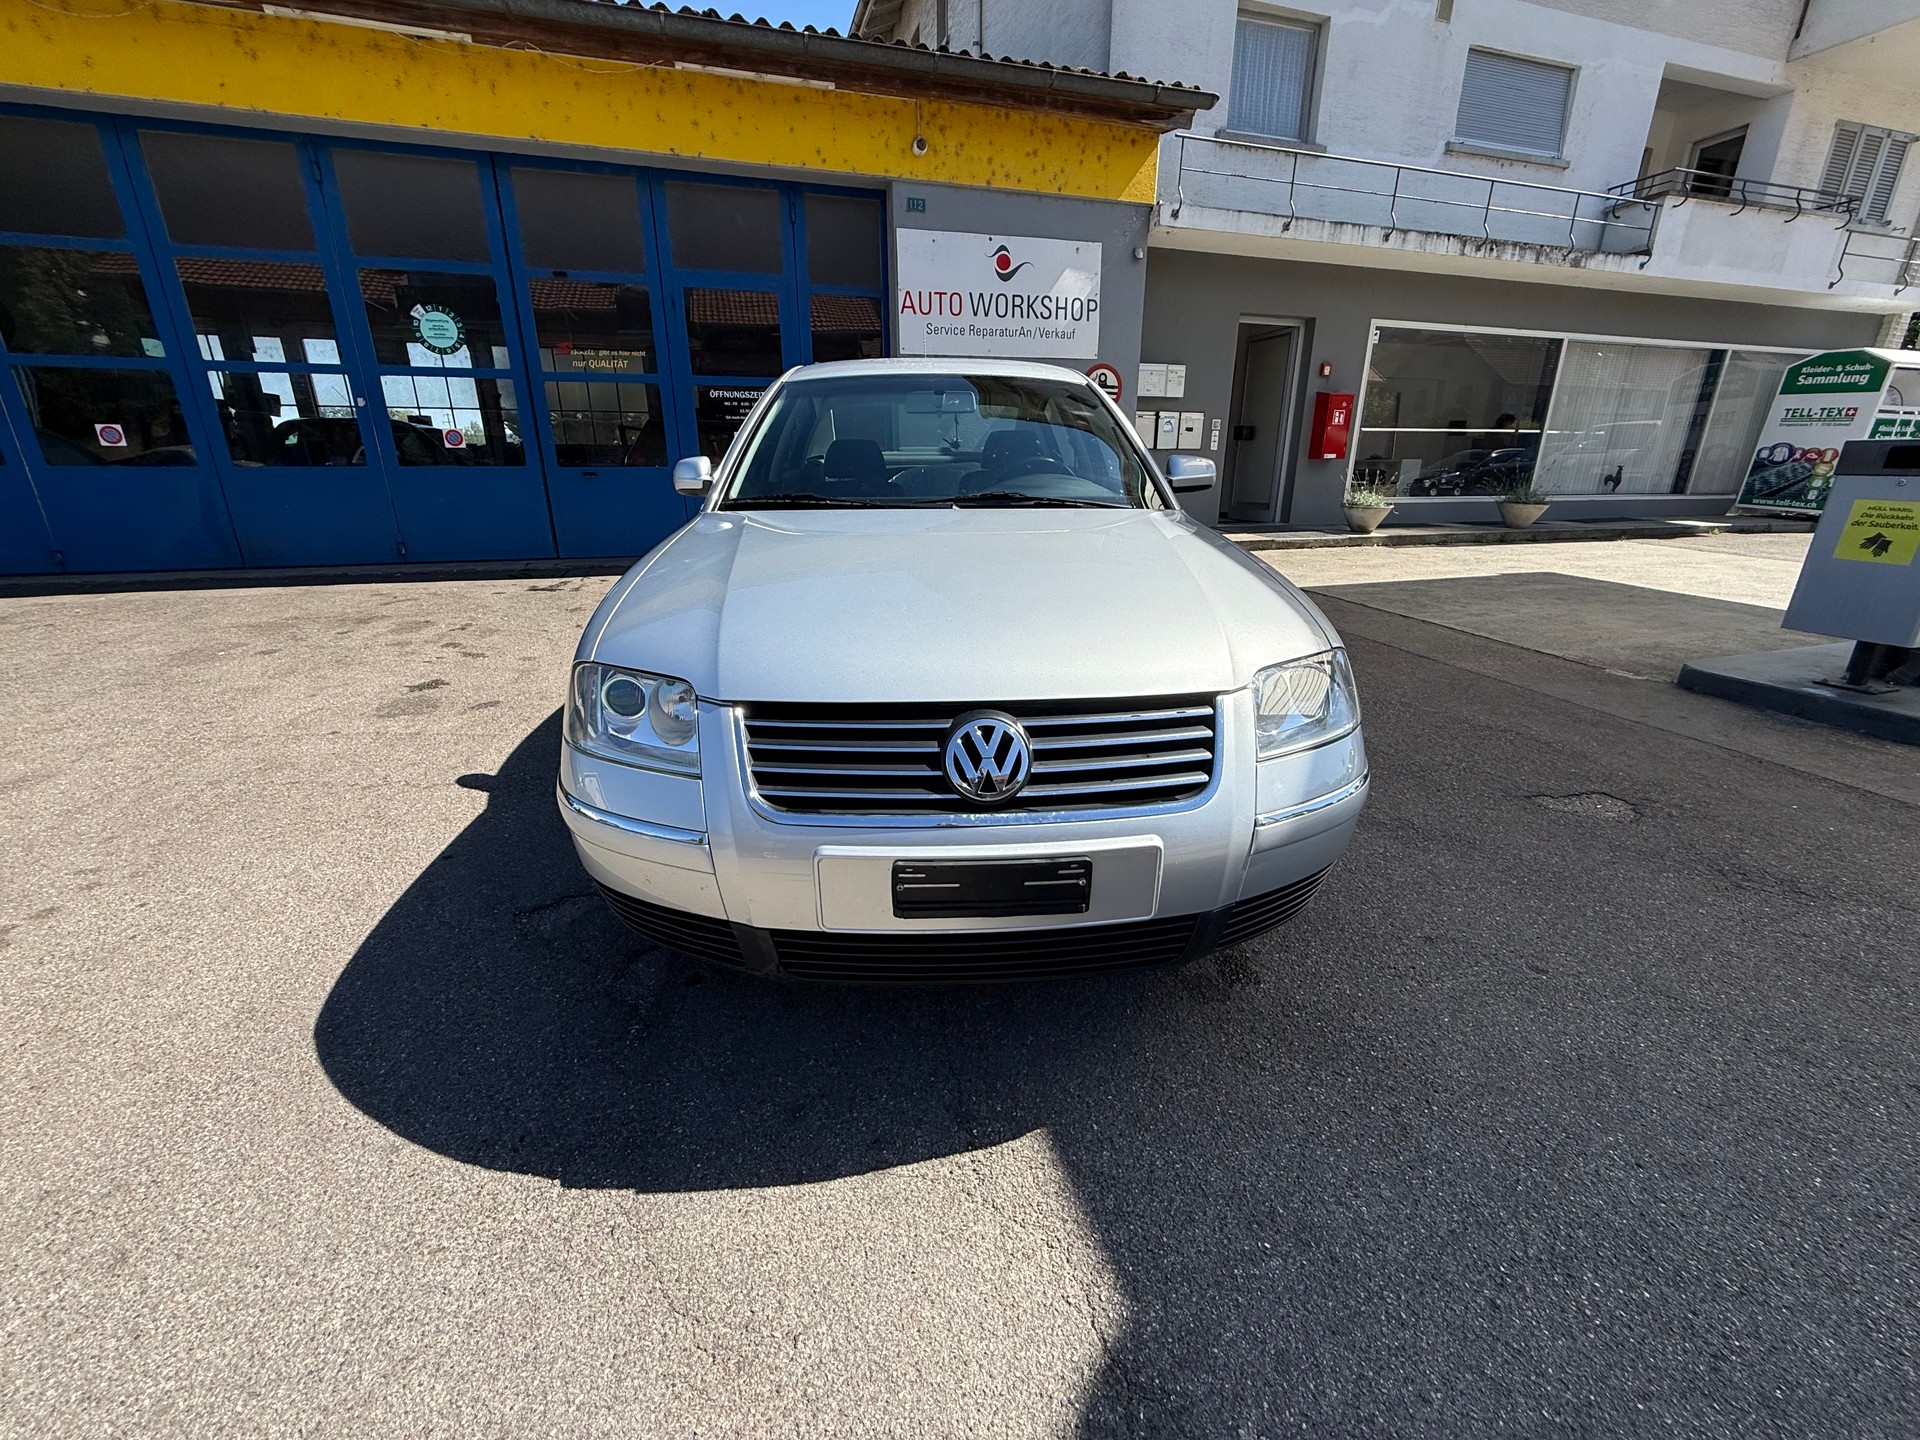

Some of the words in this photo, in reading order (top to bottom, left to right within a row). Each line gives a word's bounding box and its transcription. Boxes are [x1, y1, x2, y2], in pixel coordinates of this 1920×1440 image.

[908, 200, 924, 210] 112
[900, 290, 963, 317] AUTO
[968, 291, 1099, 322] WORKSHOP
[926, 322, 966, 336] Service
[598, 349, 610, 357] gibt
[588, 359, 629, 368] QUALITÄT
[1801, 365, 1834, 374] Kleider-
[1836, 364, 1843, 372] &
[1844, 363, 1875, 371] Schuh-
[1796, 372, 1870, 385] Sammlung
[1784, 407, 1845, 418] TELL-TEX
[1752, 498, 1818, 508] www.tell-tex.ch
[1876, 512, 1915, 521] Rückkehr
[1851, 518, 1867, 527] der
[1868, 520, 1919, 531] Sauberkeit
[948, 720, 1027, 798] VW
